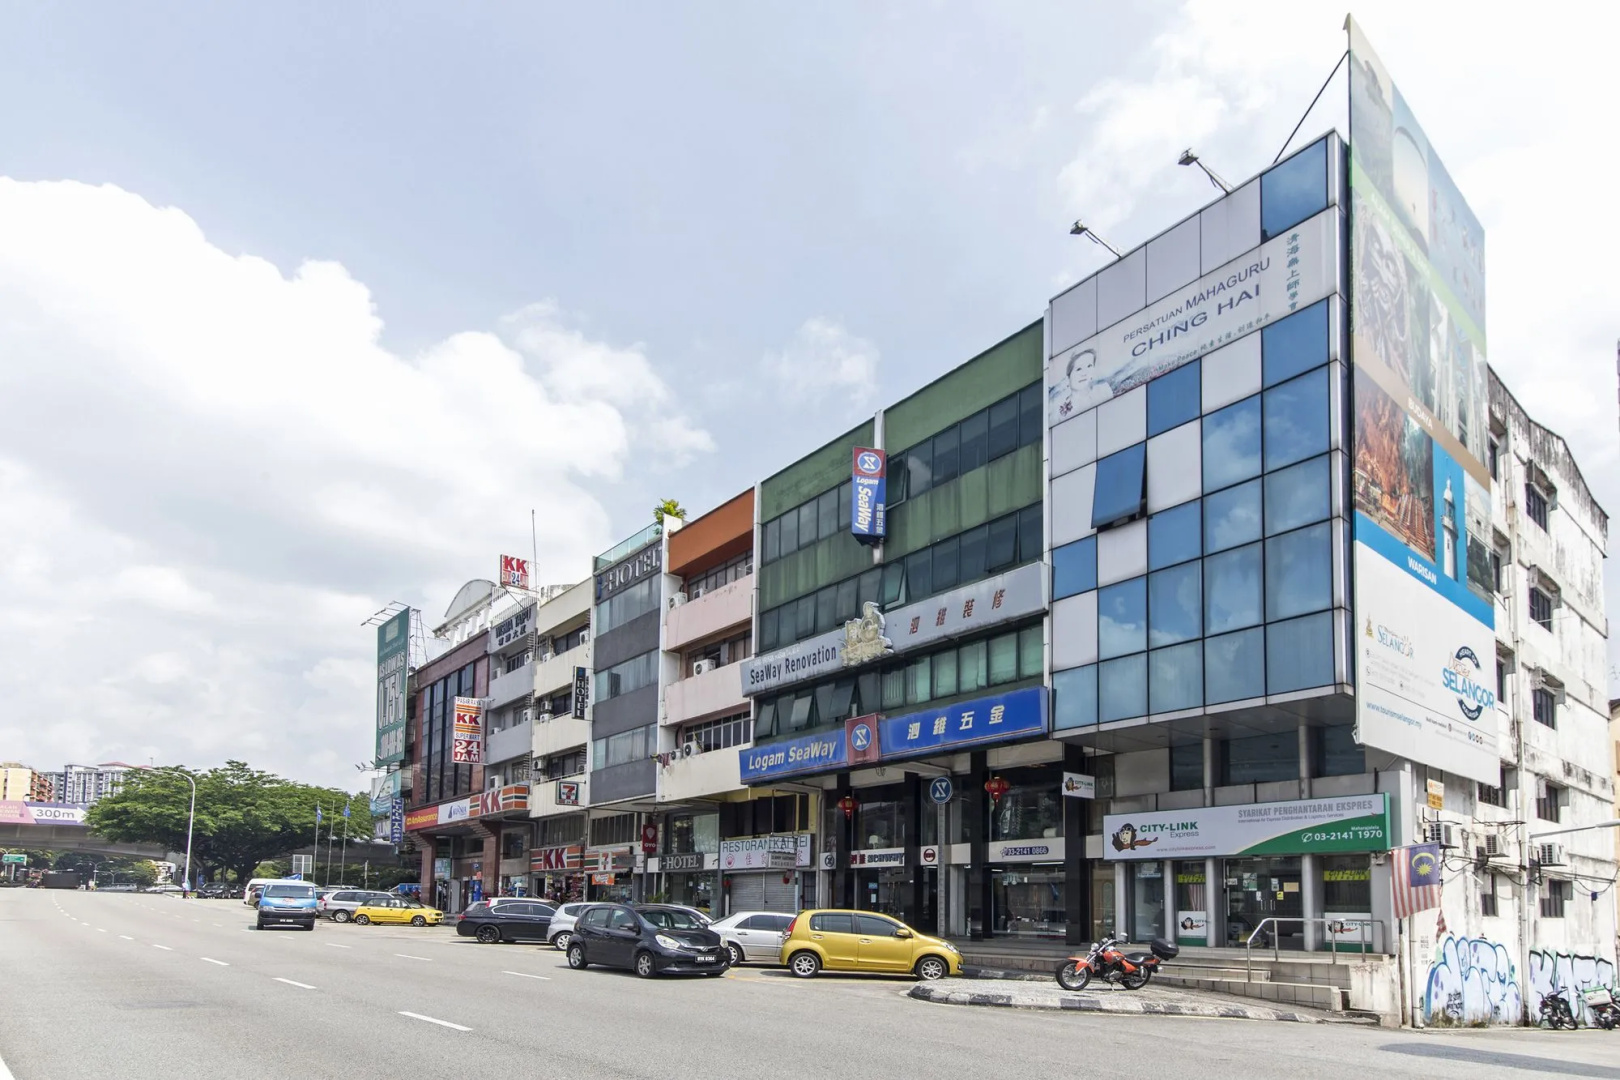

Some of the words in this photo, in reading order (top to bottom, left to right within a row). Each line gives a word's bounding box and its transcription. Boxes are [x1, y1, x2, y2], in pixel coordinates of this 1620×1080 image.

[1123, 306, 1183, 343] PERSATUAN
[1185, 257, 1270, 311] MAHAGURU
[1131, 311, 1208, 357] CHING
[1216, 283, 1260, 317] HAI
[855, 486, 872, 532] SeaWay
[504, 555, 528, 575] KK
[1408, 556, 1436, 585] WARISAN
[750, 662, 782, 685] SeaWay
[785, 645, 837, 674] Renovation
[1443, 667, 1496, 711] SELANGOR
[457, 713, 480, 725] KK
[455, 740, 479, 754] 24
[749, 752, 785, 771] Logam
[788, 741, 837, 763] SeaWay
[455, 753, 479, 762] JAM
[480, 790, 501, 814] KK
[1238, 808, 1272, 819] SYARIKAT
[1274, 803, 1334, 816] PENGHANTARAN
[1336, 800, 1373, 812] EKSPRES
[36, 808, 75, 819] 300m
[1140, 821, 1199, 834] CITY-LINK
[1170, 830, 1200, 840] Express
[1314, 832, 1353, 841] 03-2141
[1357, 830, 1383, 840] 1970
[722, 839, 769, 853] RESTORAN
[543, 848, 569, 870] KK
